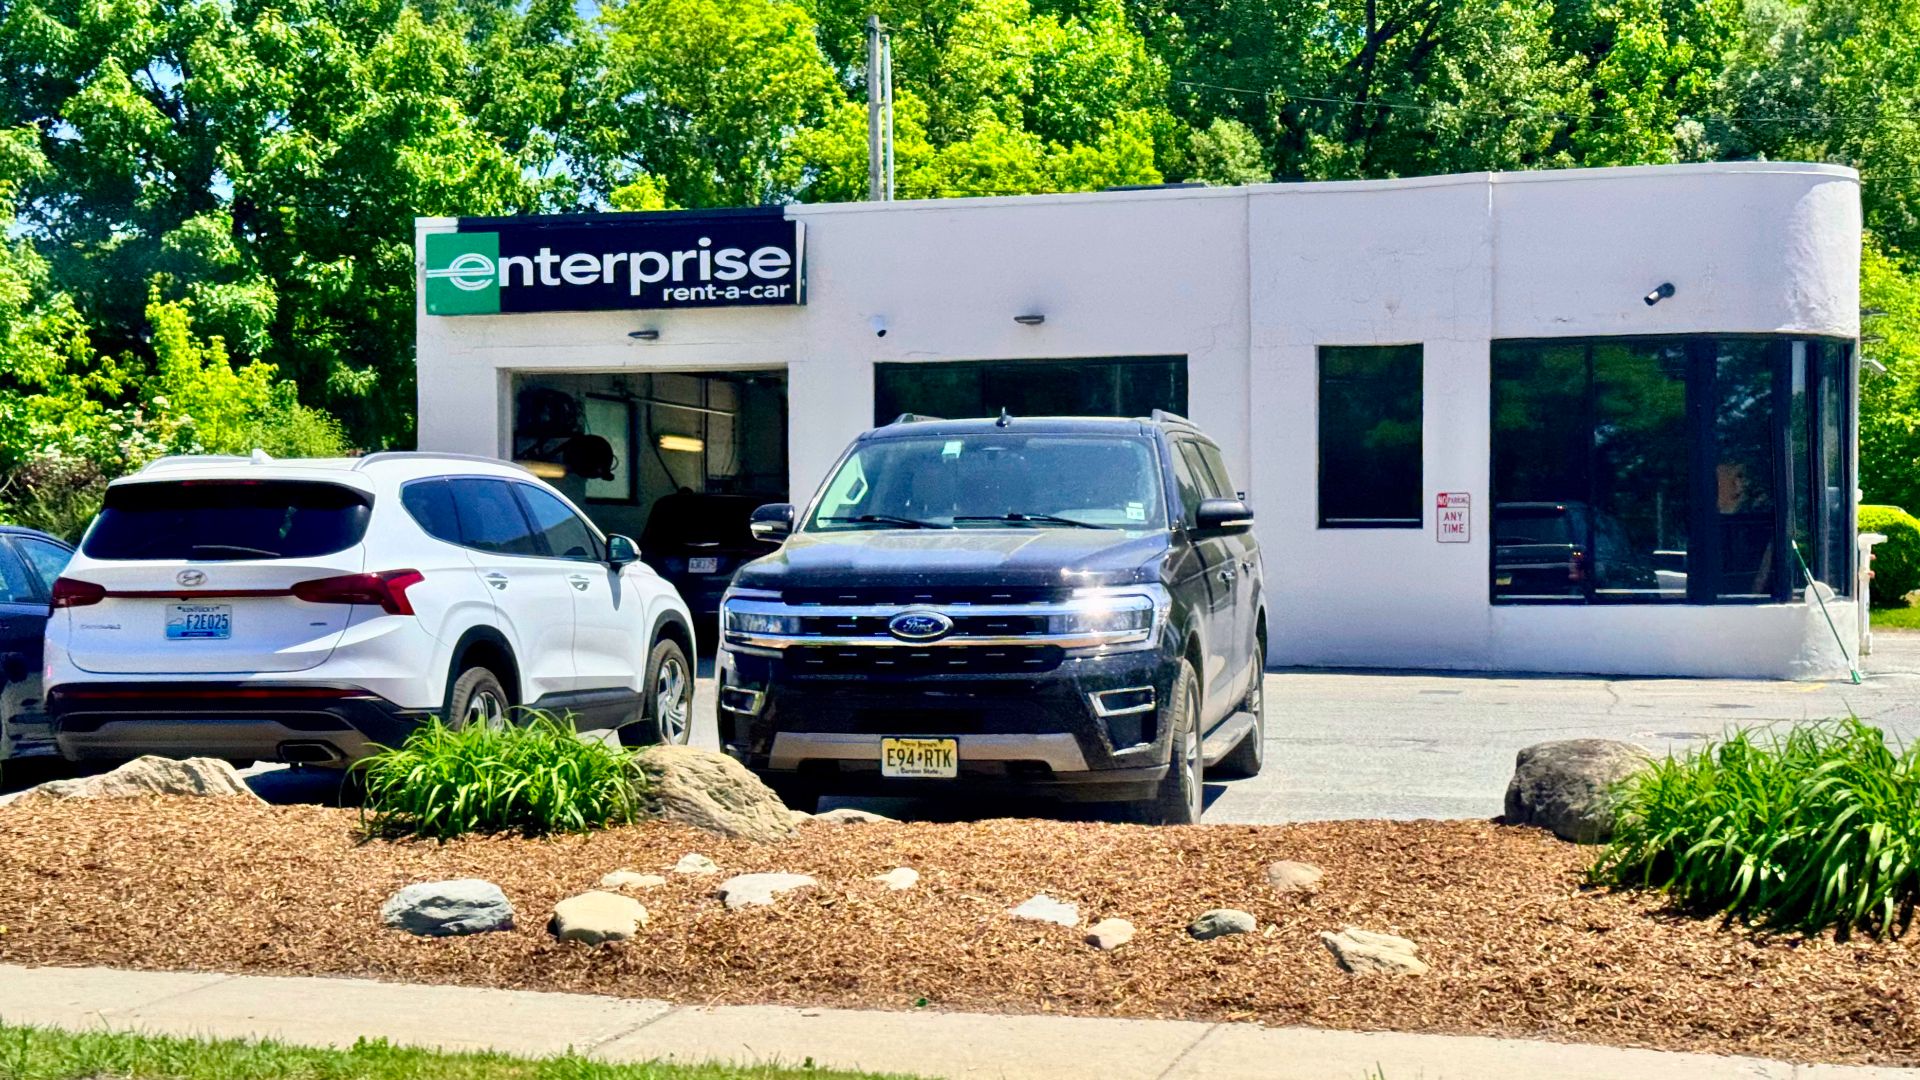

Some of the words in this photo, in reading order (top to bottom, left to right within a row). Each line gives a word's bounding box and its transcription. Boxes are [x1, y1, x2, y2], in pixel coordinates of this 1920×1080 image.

[426, 236, 792, 297] enterprise
[663, 283, 791, 301] rent-a-car
[1444, 511, 1463, 521] ANY
[1442, 523, 1465, 533] TIME
[186, 614, 229, 630] F2E025
